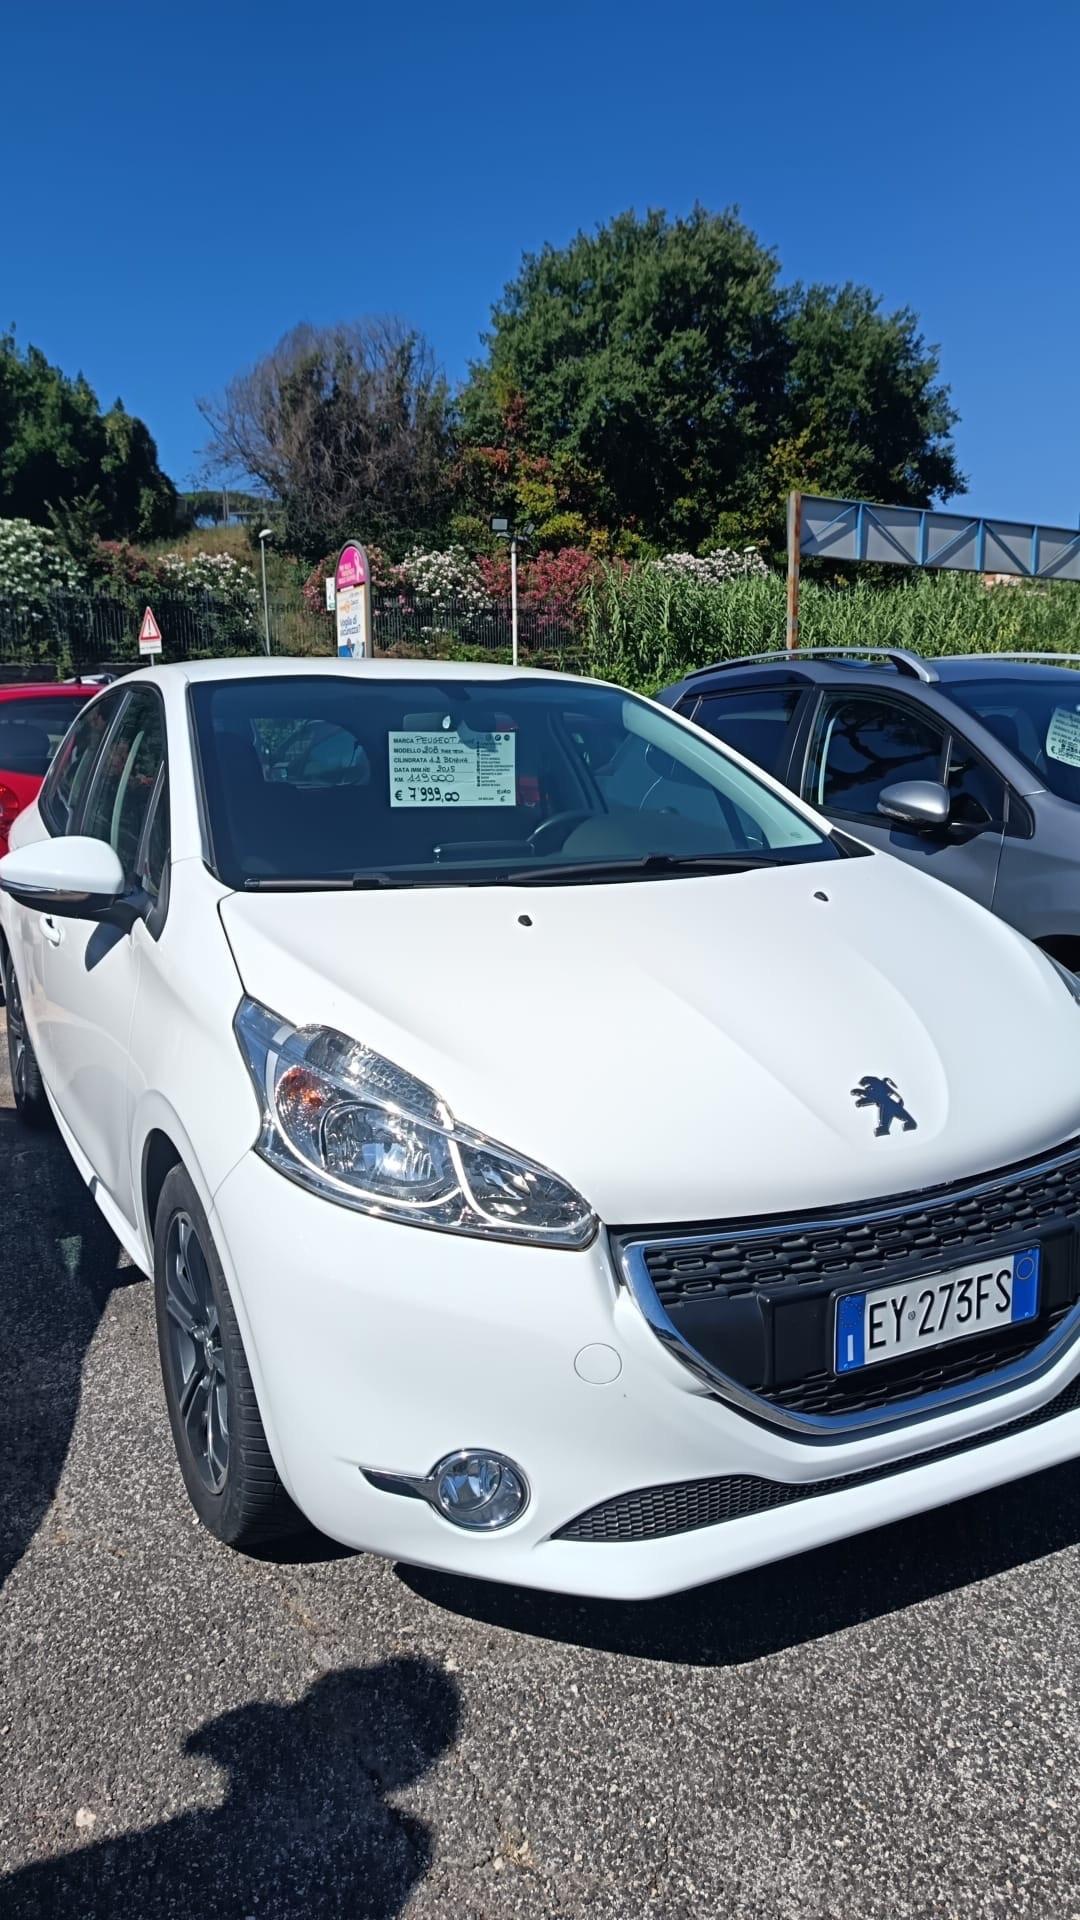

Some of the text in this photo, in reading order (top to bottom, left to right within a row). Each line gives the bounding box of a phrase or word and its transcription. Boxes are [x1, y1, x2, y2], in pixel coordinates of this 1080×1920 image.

[415, 736, 457, 744] PEUGEOT
[422, 746, 439, 754] 208
[436, 765, 456, 773] 2015
[394, 790, 403, 801] €
[868, 1295, 908, 1349] EY
[918, 1269, 1012, 1337] 273FS
